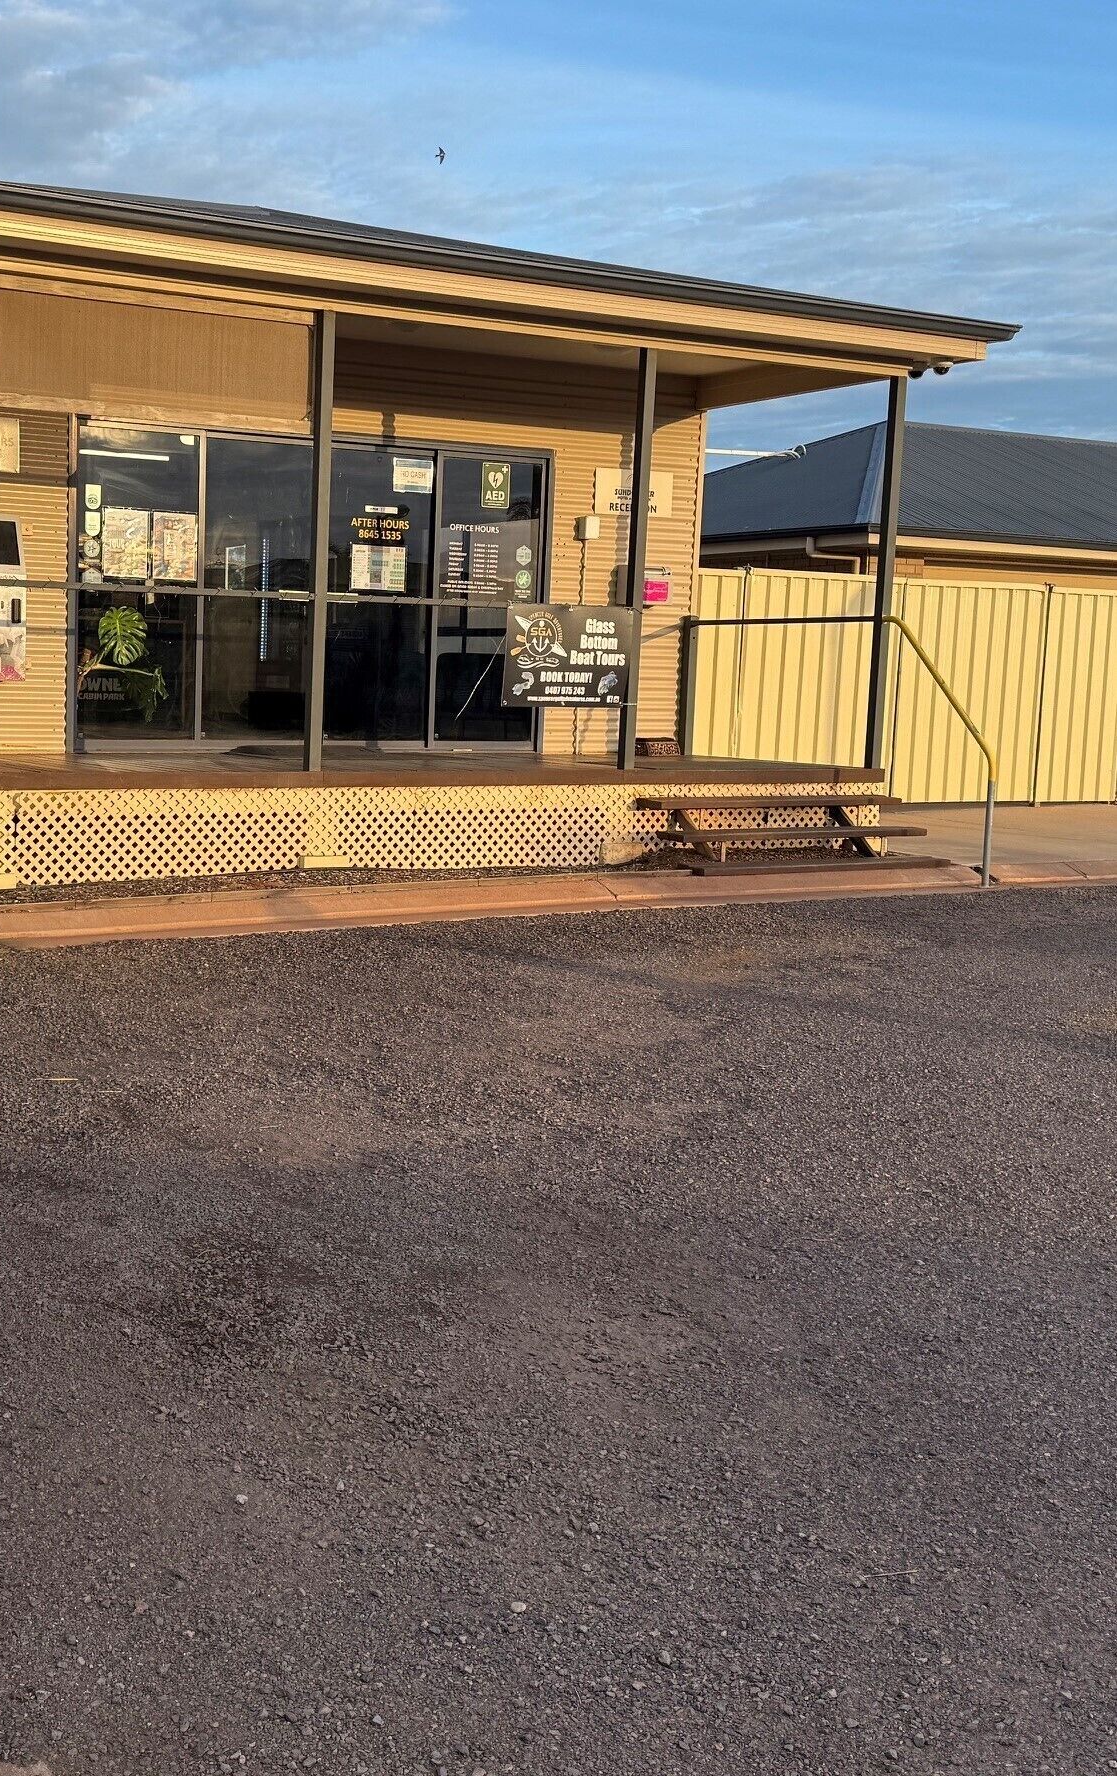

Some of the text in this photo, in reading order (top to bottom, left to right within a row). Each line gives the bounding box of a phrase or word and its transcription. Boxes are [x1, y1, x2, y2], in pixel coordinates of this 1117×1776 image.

[410, 471, 426, 479] CASH
[485, 490, 505, 500] AED
[609, 502, 657, 514] RECEN
[351, 517, 410, 530] AFTER HOURS
[449, 523, 500, 534] OFFICE HOURS
[358, 528, 401, 540] 8645 1535
[530, 627, 553, 637] SGA
[585, 618, 615, 634] Glass
[580, 634, 618, 650] Bottom
[569, 649, 626, 667] Boat Tours
[540, 671, 593, 684] BOOK TODAY!
